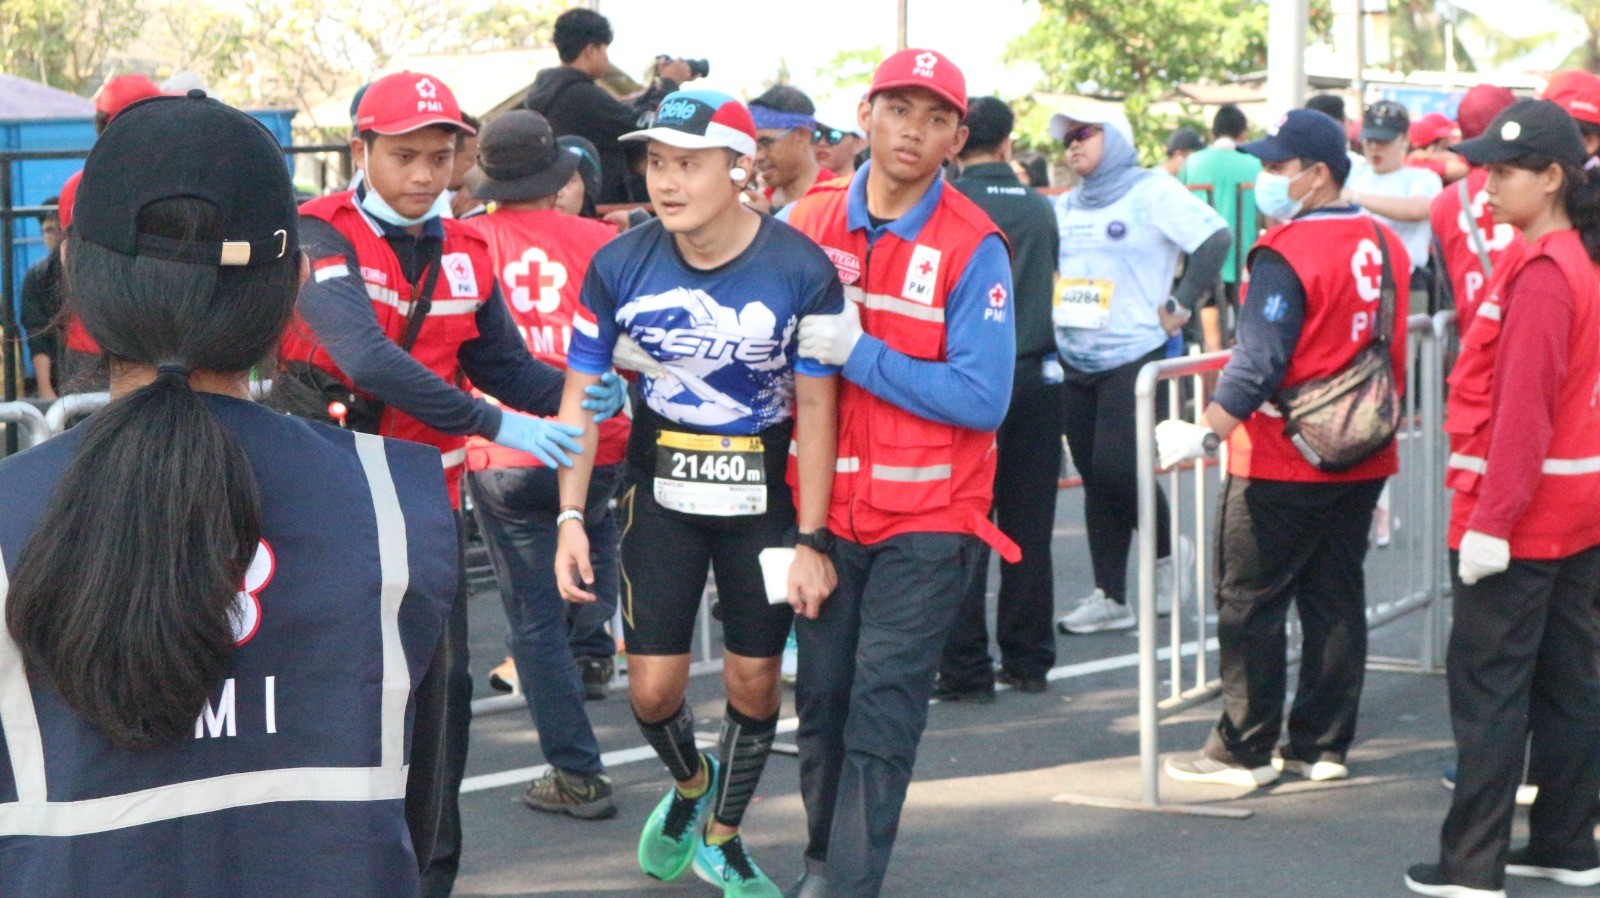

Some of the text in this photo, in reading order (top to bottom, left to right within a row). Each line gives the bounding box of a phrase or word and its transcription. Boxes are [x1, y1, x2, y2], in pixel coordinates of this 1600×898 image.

[912, 66, 934, 79] PMI
[417, 101, 443, 112] PMI
[909, 281, 931, 296] PMI
[984, 307, 1006, 323] PMI
[194, 675, 277, 739] MI
